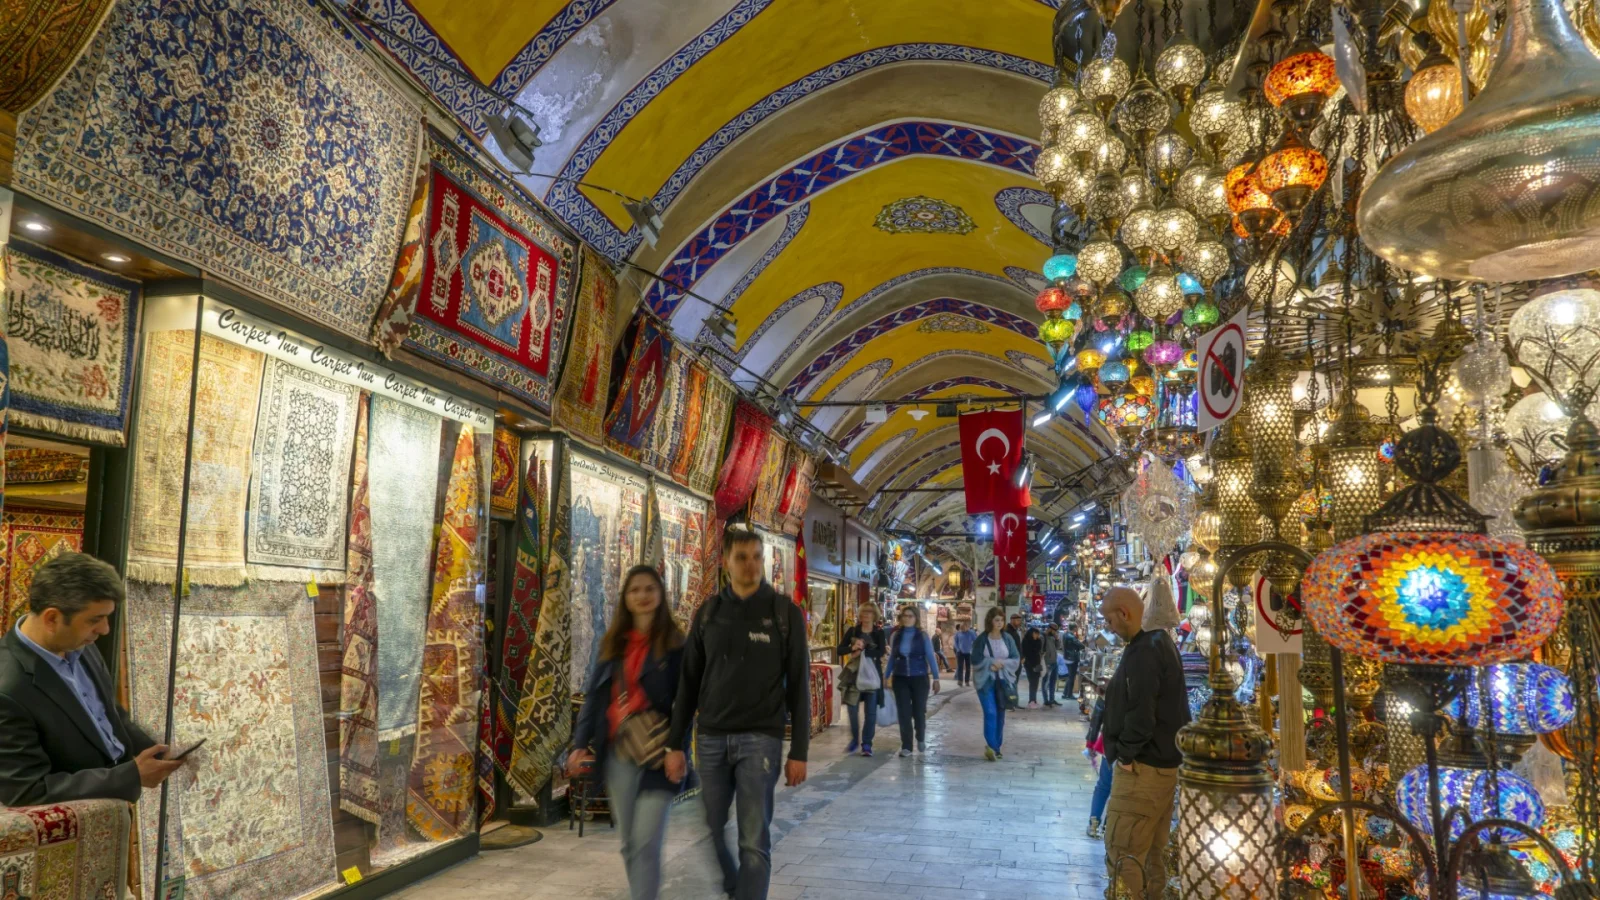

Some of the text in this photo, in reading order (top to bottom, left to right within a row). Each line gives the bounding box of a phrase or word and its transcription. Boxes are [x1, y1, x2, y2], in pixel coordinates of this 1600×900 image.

[218, 308, 488, 425] Carpet Inn Carpet Inn Carpet Inn Carpet Inn
[599, 465, 626, 484] Shipping
